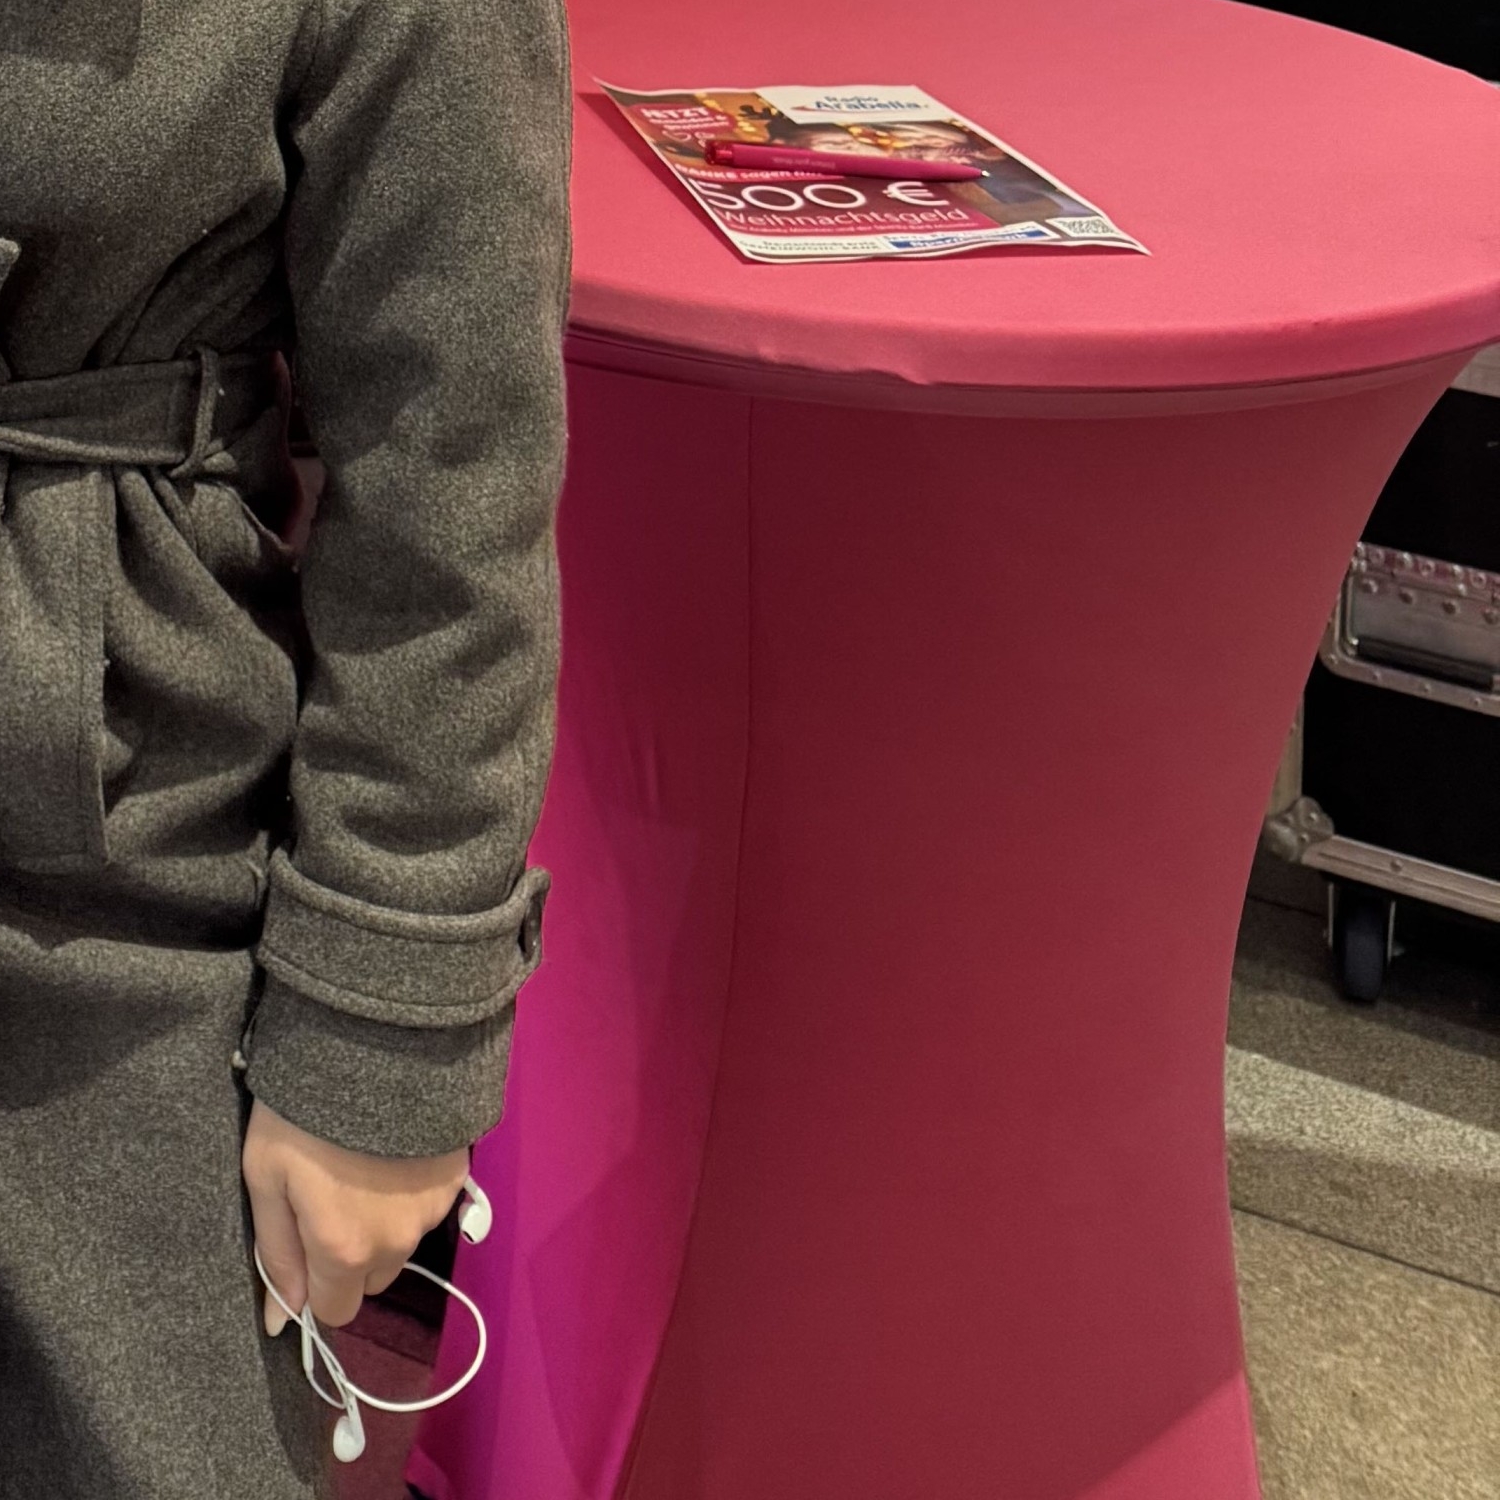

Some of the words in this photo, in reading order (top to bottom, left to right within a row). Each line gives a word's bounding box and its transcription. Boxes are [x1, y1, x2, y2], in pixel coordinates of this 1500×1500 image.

[688, 177, 867, 212] 500
[882, 180, 950, 207] €
[713, 207, 970, 227] Weihnachtsgeld
